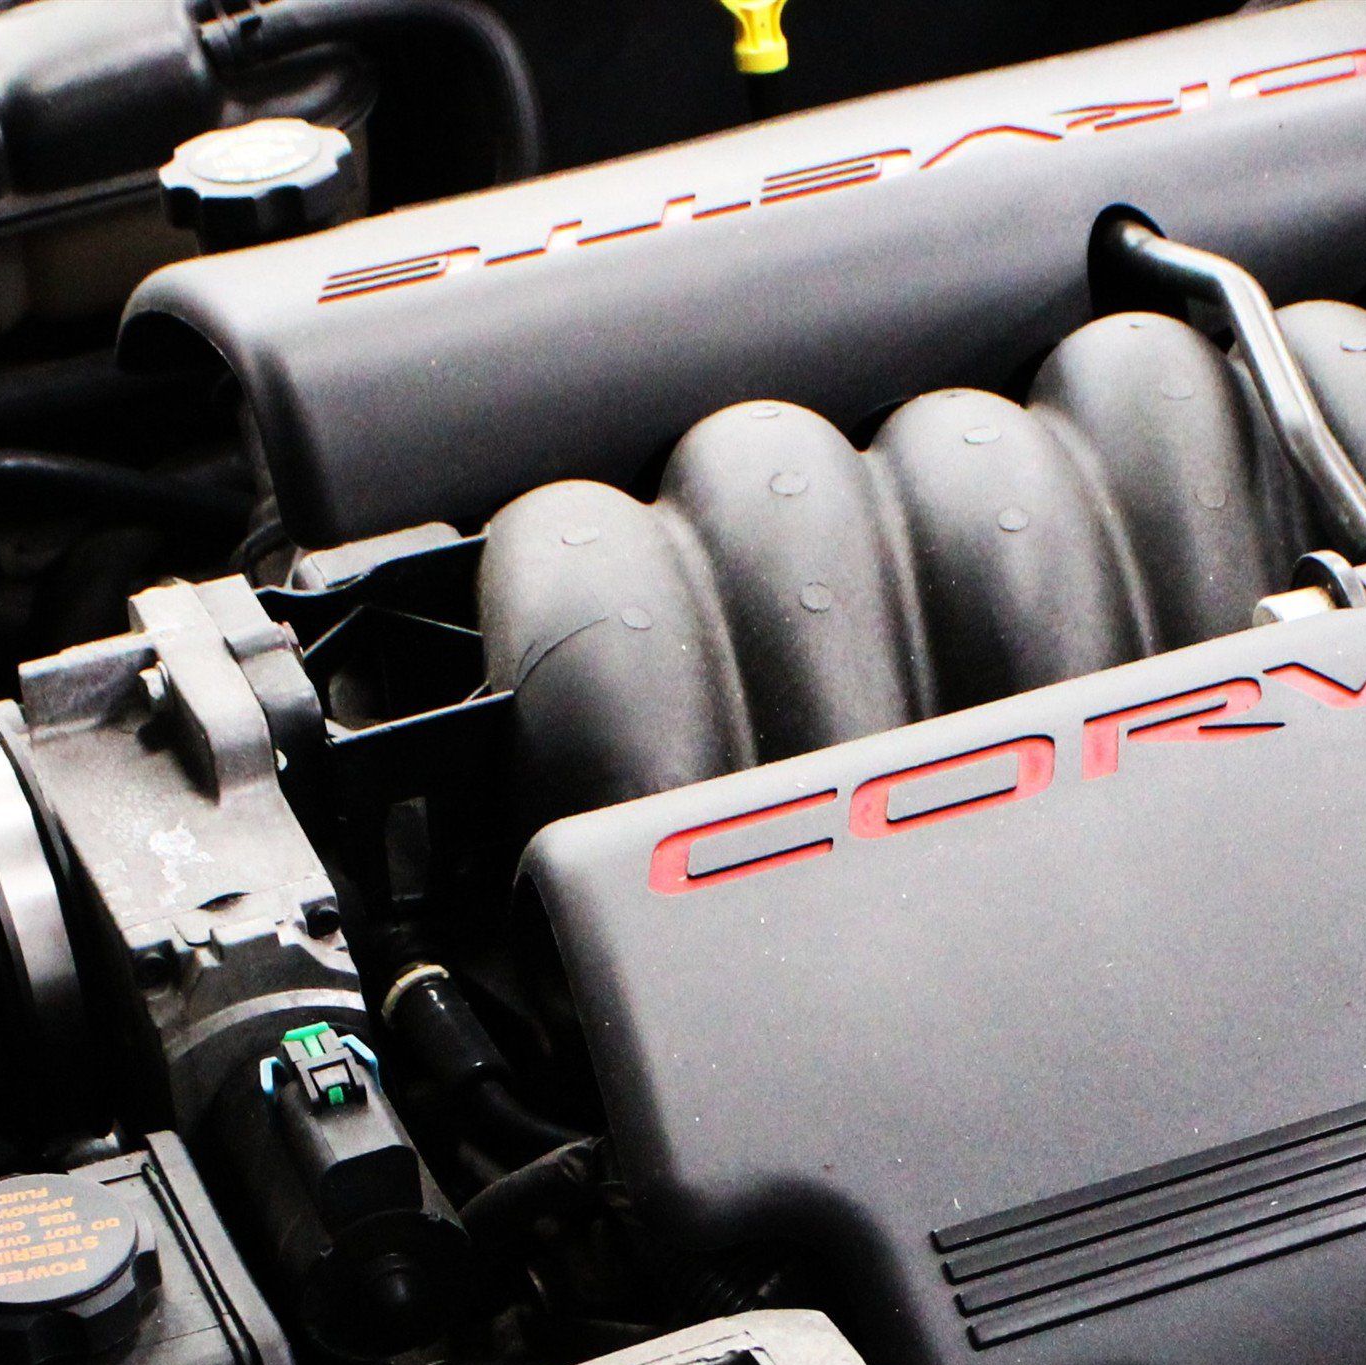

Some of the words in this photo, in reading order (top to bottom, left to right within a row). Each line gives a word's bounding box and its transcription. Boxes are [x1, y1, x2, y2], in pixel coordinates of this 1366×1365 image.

[36, 1211, 78, 1228] USE
[90, 1216, 122, 1232] DO
[43, 1224, 84, 1241] NOT
